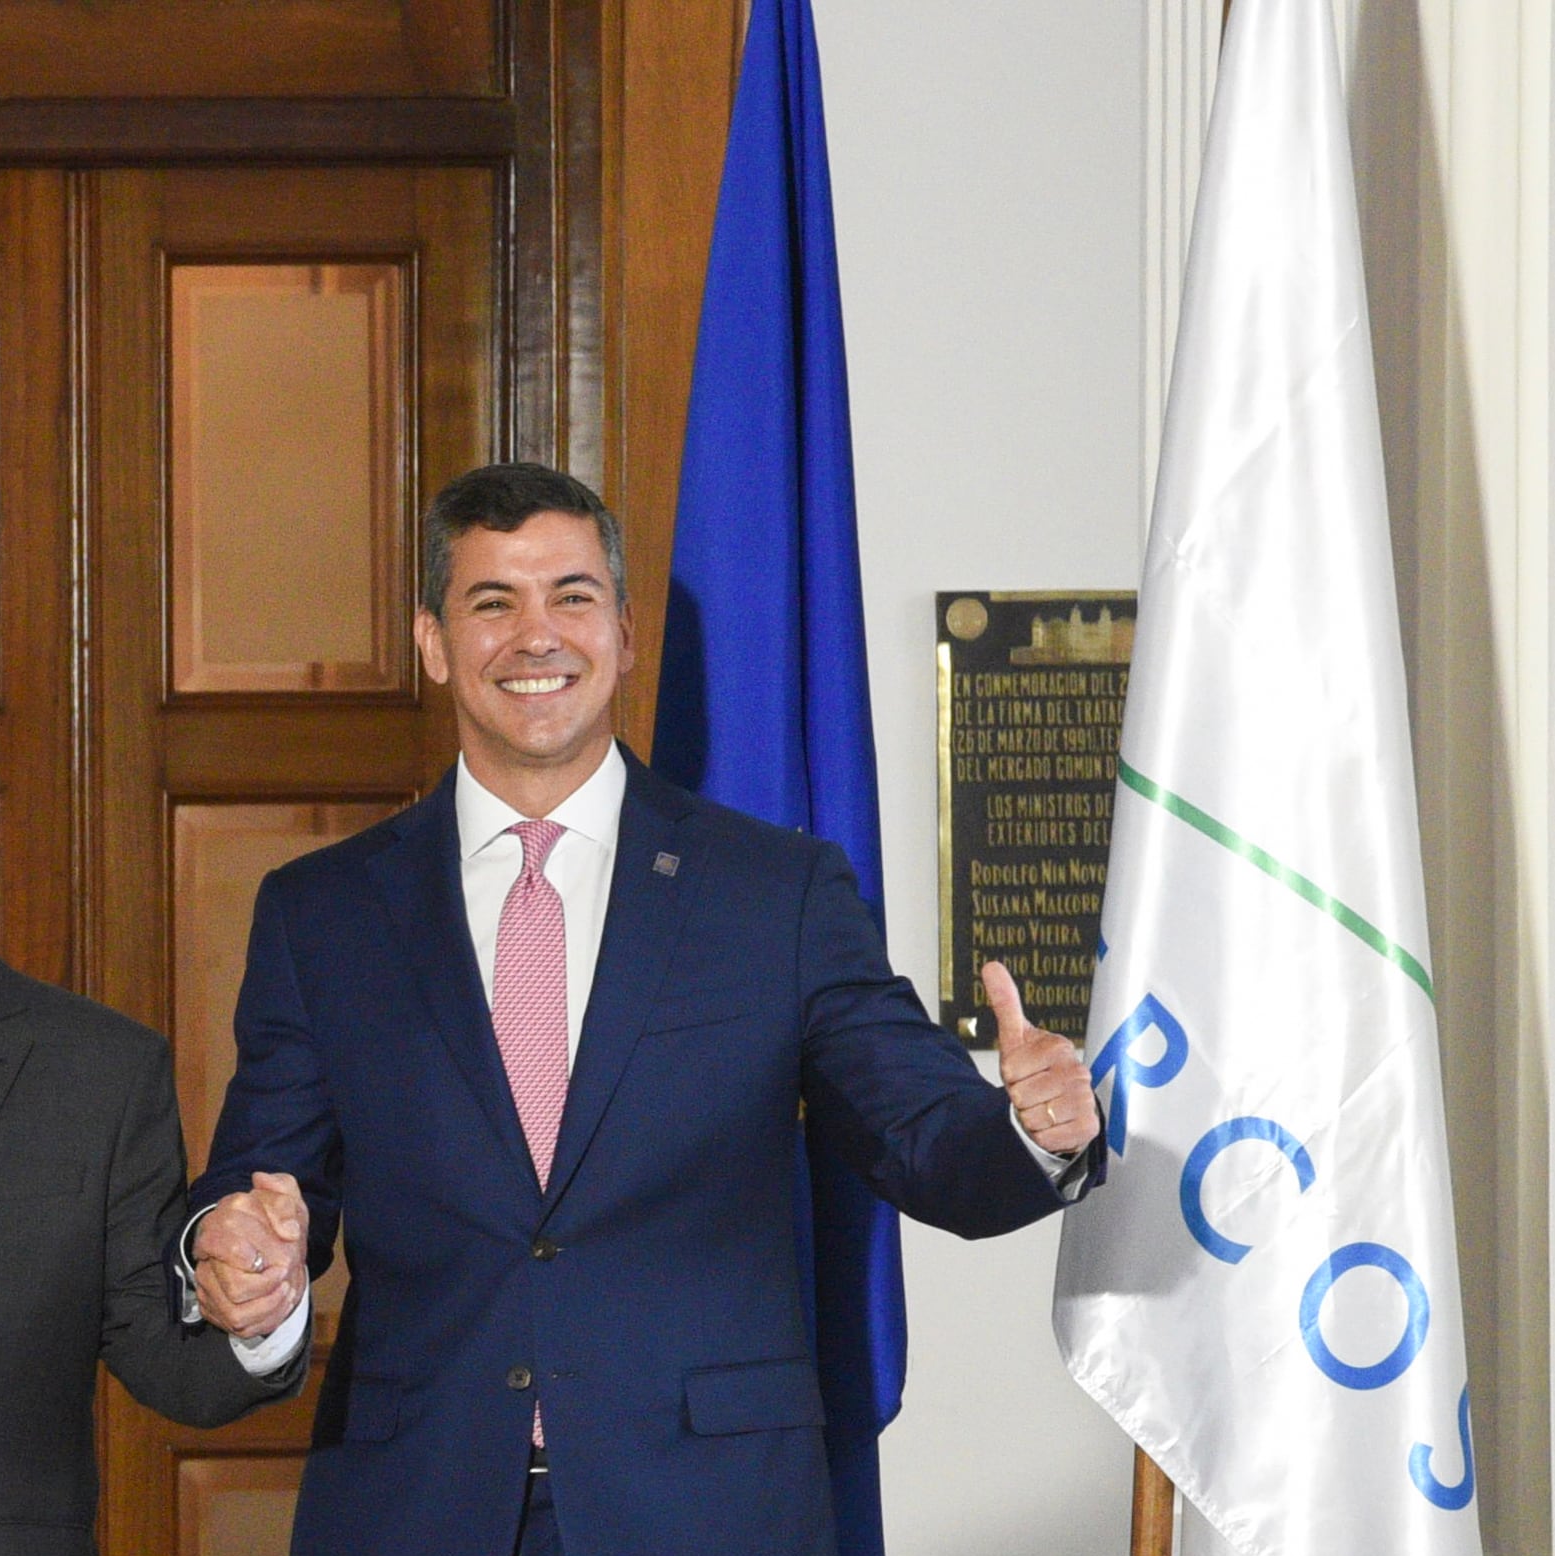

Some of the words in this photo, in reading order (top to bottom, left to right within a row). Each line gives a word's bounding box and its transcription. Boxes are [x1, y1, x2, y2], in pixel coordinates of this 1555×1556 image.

[954, 673, 971, 698] EN
[1091, 672, 1116, 697] DEL
[955, 701, 972, 726] DE
[977, 701, 995, 726] LA
[999, 701, 1042, 725] FIRMA
[1046, 700, 1072, 725] DEL
[978, 728, 993, 753] DE
[997, 728, 1041, 753] MARZO
[1044, 728, 1058, 753] DE
[957, 757, 983, 783] DEL
[988, 756, 1051, 782] MERCADO
[1056, 755, 1102, 781] COMUN
[987, 793, 1013, 819] LOS
[1017, 793, 1090, 818] MINISTROS
[1095, 793, 1112, 818] DE
[987, 821, 1077, 847] EXTERIORES
[1083, 820, 1110, 846] DEL
[1091, 992, 1474, 1511] RCOS
